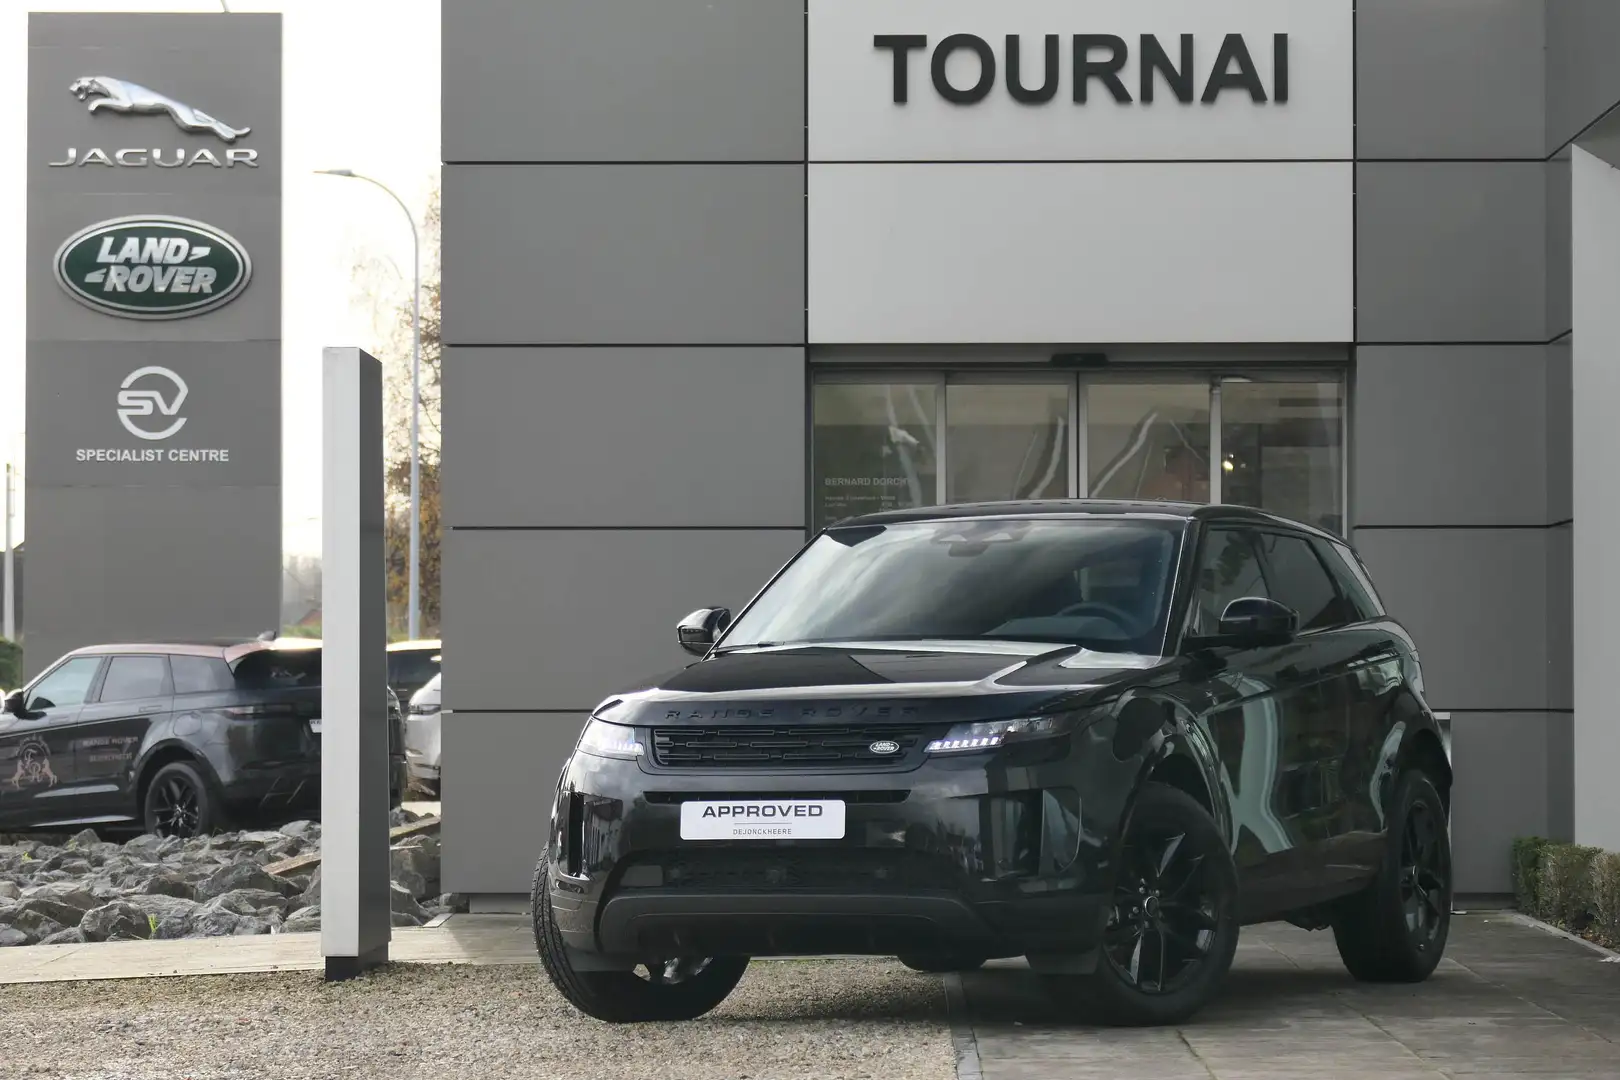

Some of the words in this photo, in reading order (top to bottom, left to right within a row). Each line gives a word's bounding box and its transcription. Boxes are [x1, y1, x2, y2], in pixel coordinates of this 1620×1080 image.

[873, 33, 1289, 105] TOURNAI
[48, 147, 260, 169] JAGUAR
[96, 236, 194, 264] LAND
[103, 265, 218, 294] ROVER
[76, 448, 164, 463] SPECIALIST
[168, 448, 229, 463] CENTRE
[824, 477, 870, 486] BERNARD
[664, 707, 775, 720] RANGE
[799, 705, 919, 718] ROVER
[702, 804, 823, 818] APPROVED
[732, 828, 792, 836] DEJONCKHEERE
